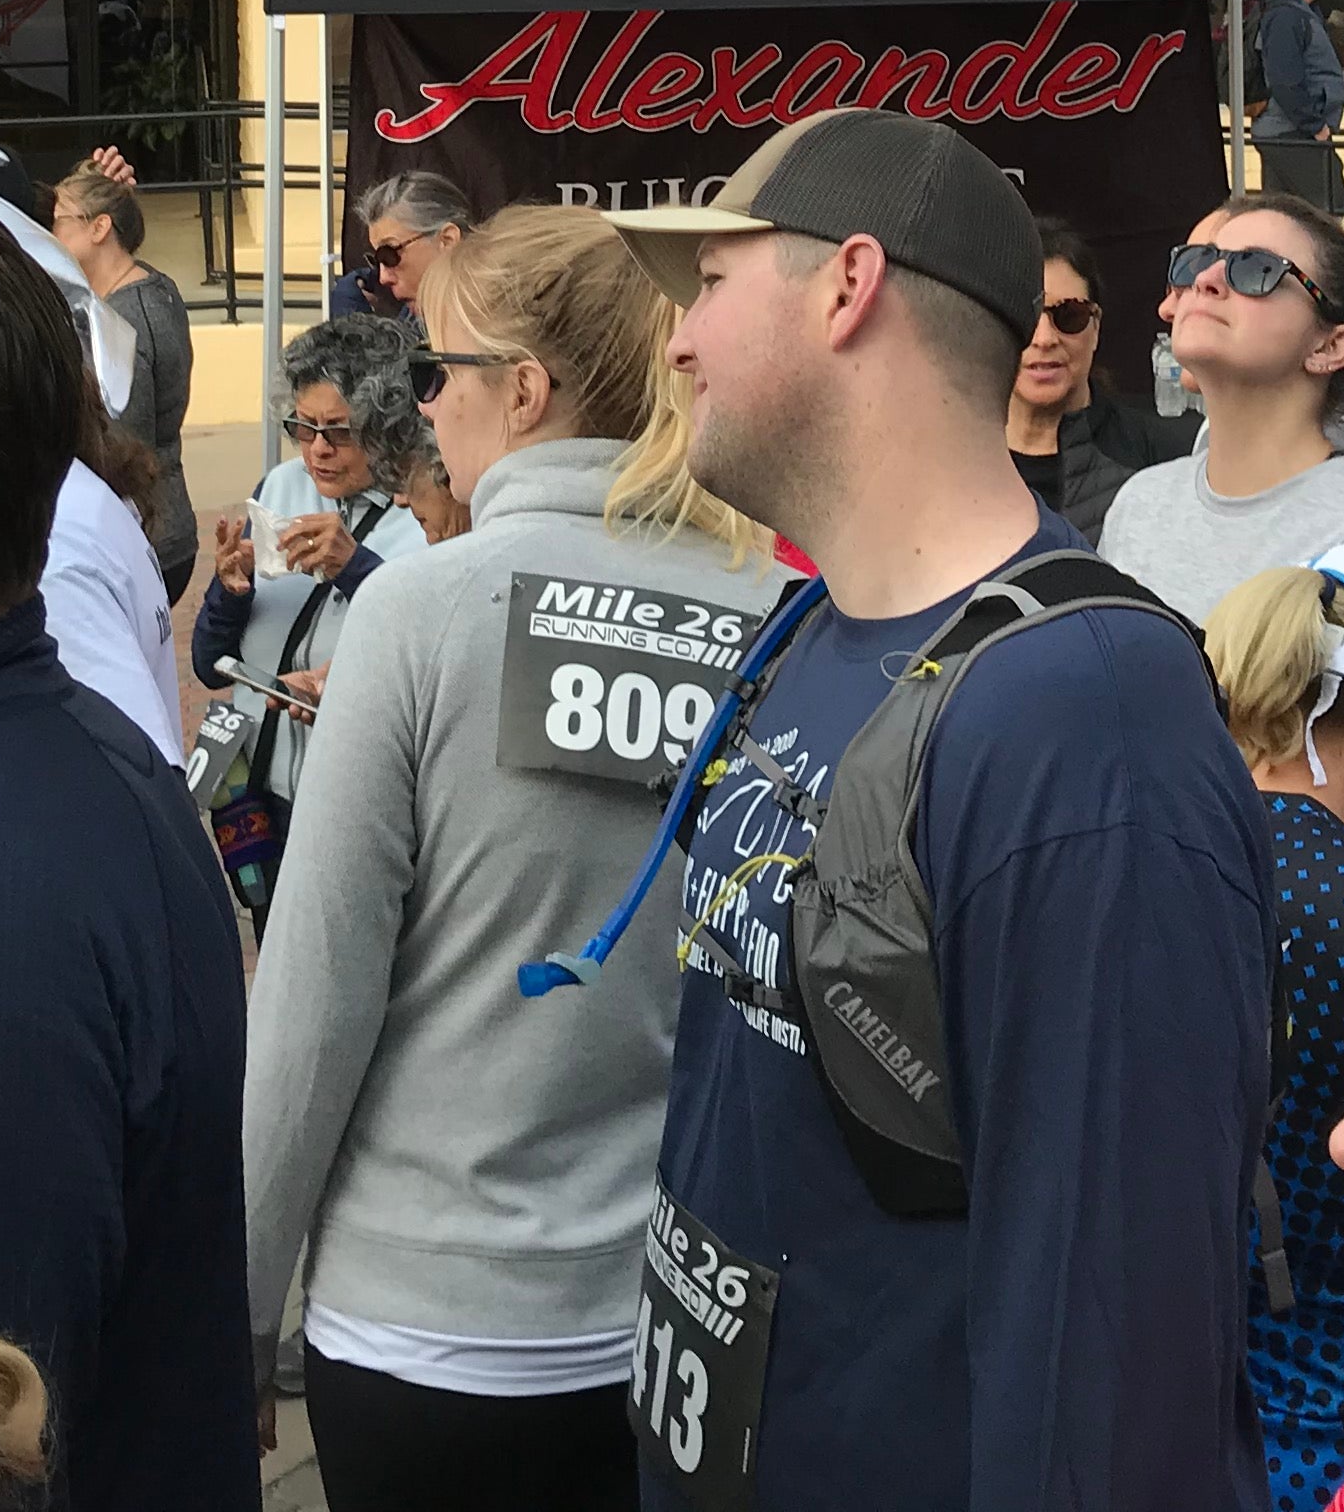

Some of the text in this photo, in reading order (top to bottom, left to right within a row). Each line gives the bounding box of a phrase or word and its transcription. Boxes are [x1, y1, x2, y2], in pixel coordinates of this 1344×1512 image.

[374, 0, 1187, 145] Alexander
[532, 616, 696, 659] RUNNING CO.
[536, 581, 743, 644] Mile 26
[210, 705, 244, 731] 26
[545, 663, 716, 767] 809
[824, 981, 943, 1104] CAMELBAK
[653, 1184, 691, 1265] ile
[692, 1240, 751, 1309] 26
[632, 1291, 709, 1474] 413
